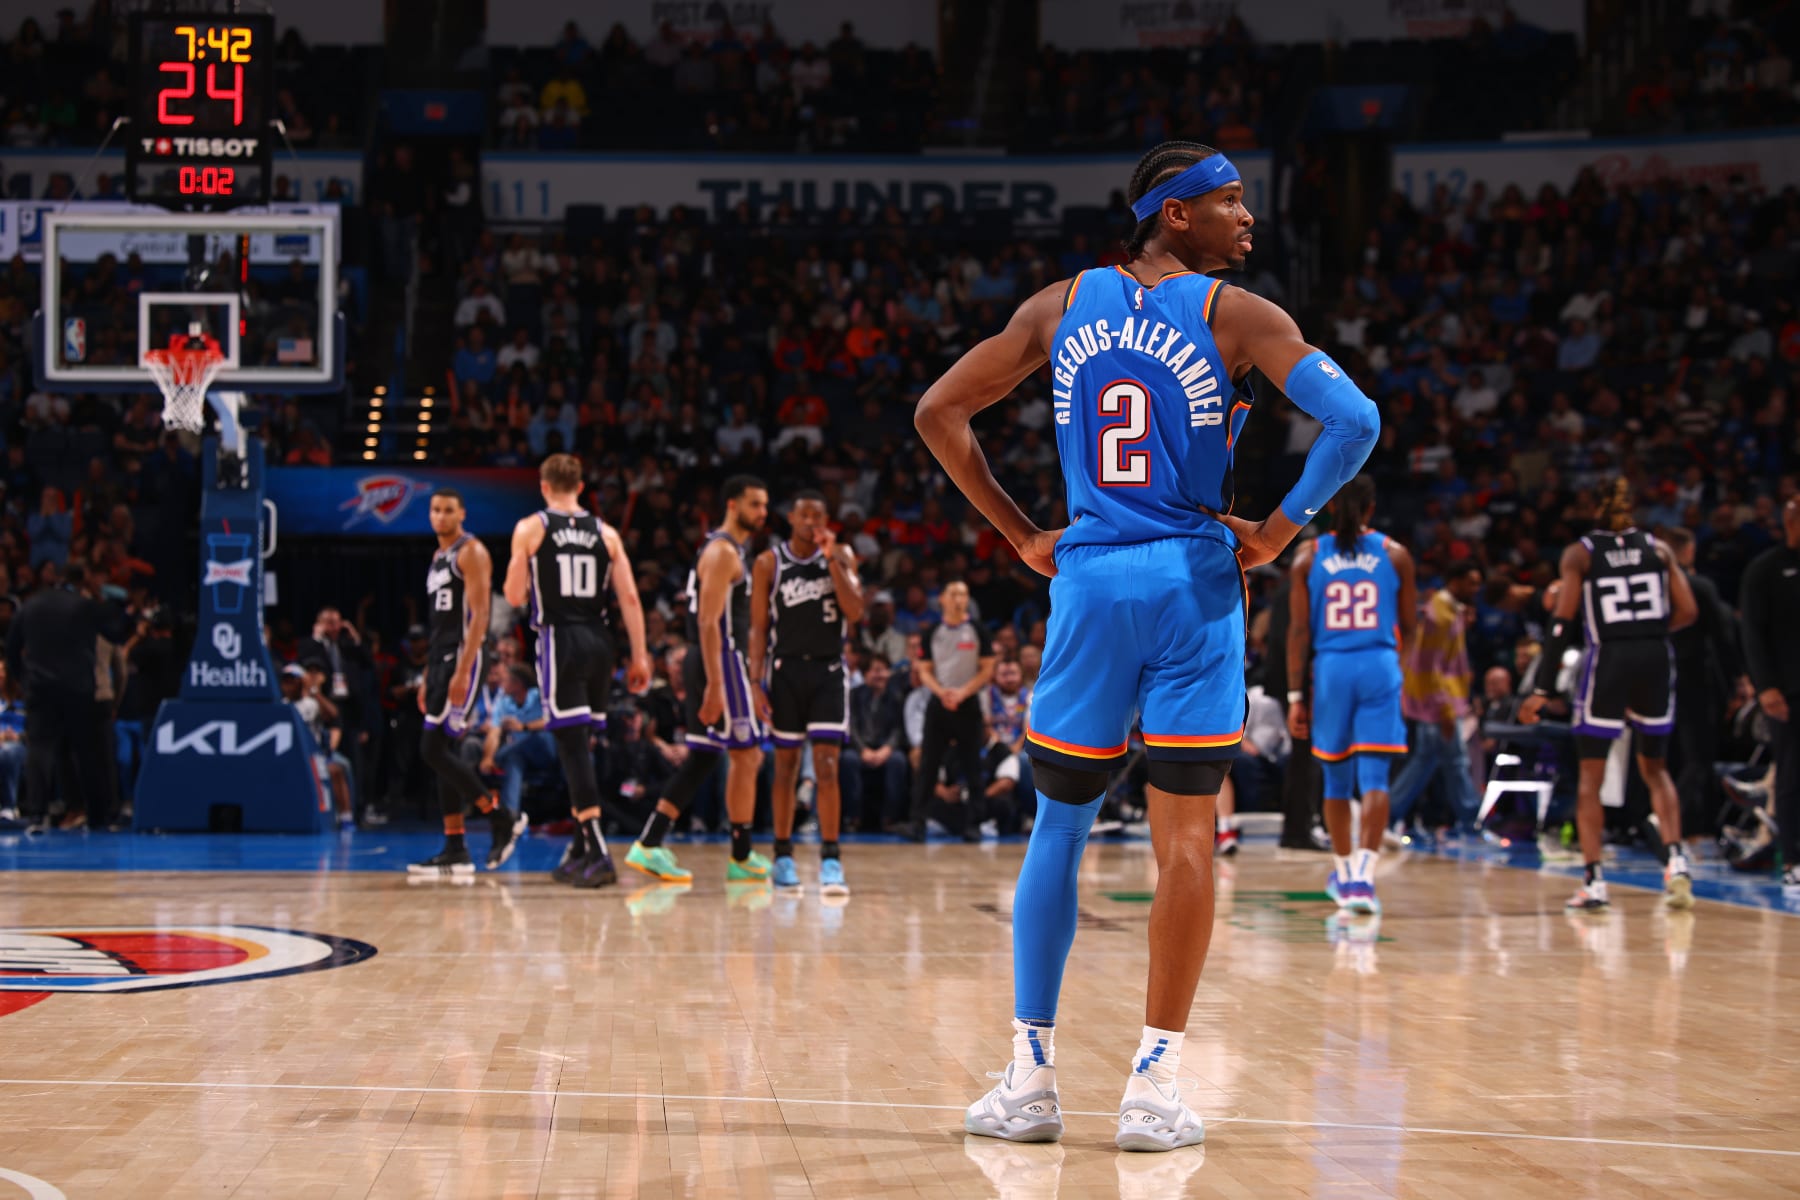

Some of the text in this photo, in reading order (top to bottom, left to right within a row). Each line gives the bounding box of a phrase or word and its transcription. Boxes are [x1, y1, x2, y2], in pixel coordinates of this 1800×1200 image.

[174, 26, 253, 63] 7:42
[157, 62, 245, 127] 24
[175, 137, 260, 159] TISSOT
[179, 166, 235, 195] 0:02
[489, 181, 550, 217] 111
[699, 178, 1058, 223] THUNDER
[1053, 317, 1224, 427] GILGEOUS-ALEXANDER
[1098, 379, 1150, 488] 2
[555, 553, 597, 598] 10
[822, 599, 838, 624] 5
[1325, 580, 1379, 631] 22
[1596, 571, 1664, 625] 23
[211, 620, 242, 661] OU
[190, 659, 267, 687] Health
